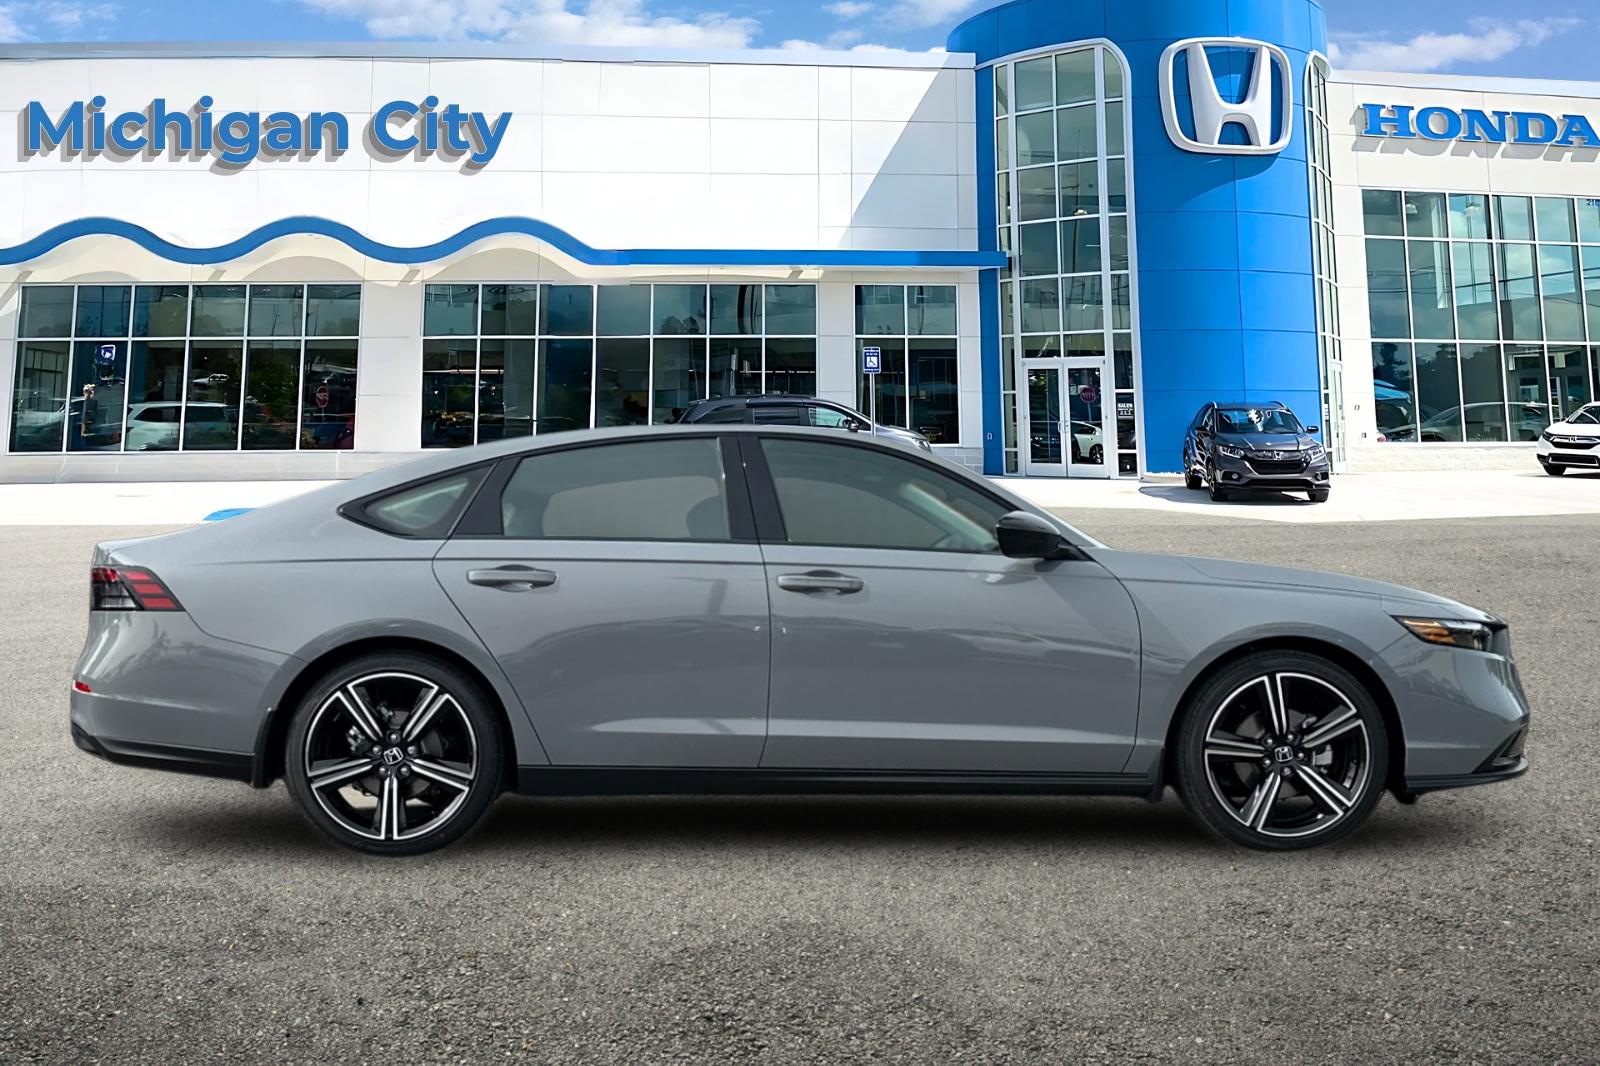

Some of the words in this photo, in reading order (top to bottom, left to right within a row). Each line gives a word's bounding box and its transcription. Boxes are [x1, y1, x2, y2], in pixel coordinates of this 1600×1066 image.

[27, 95, 350, 164] Michigan
[373, 95, 513, 164] City
[1361, 103, 1600, 147] HONDA
